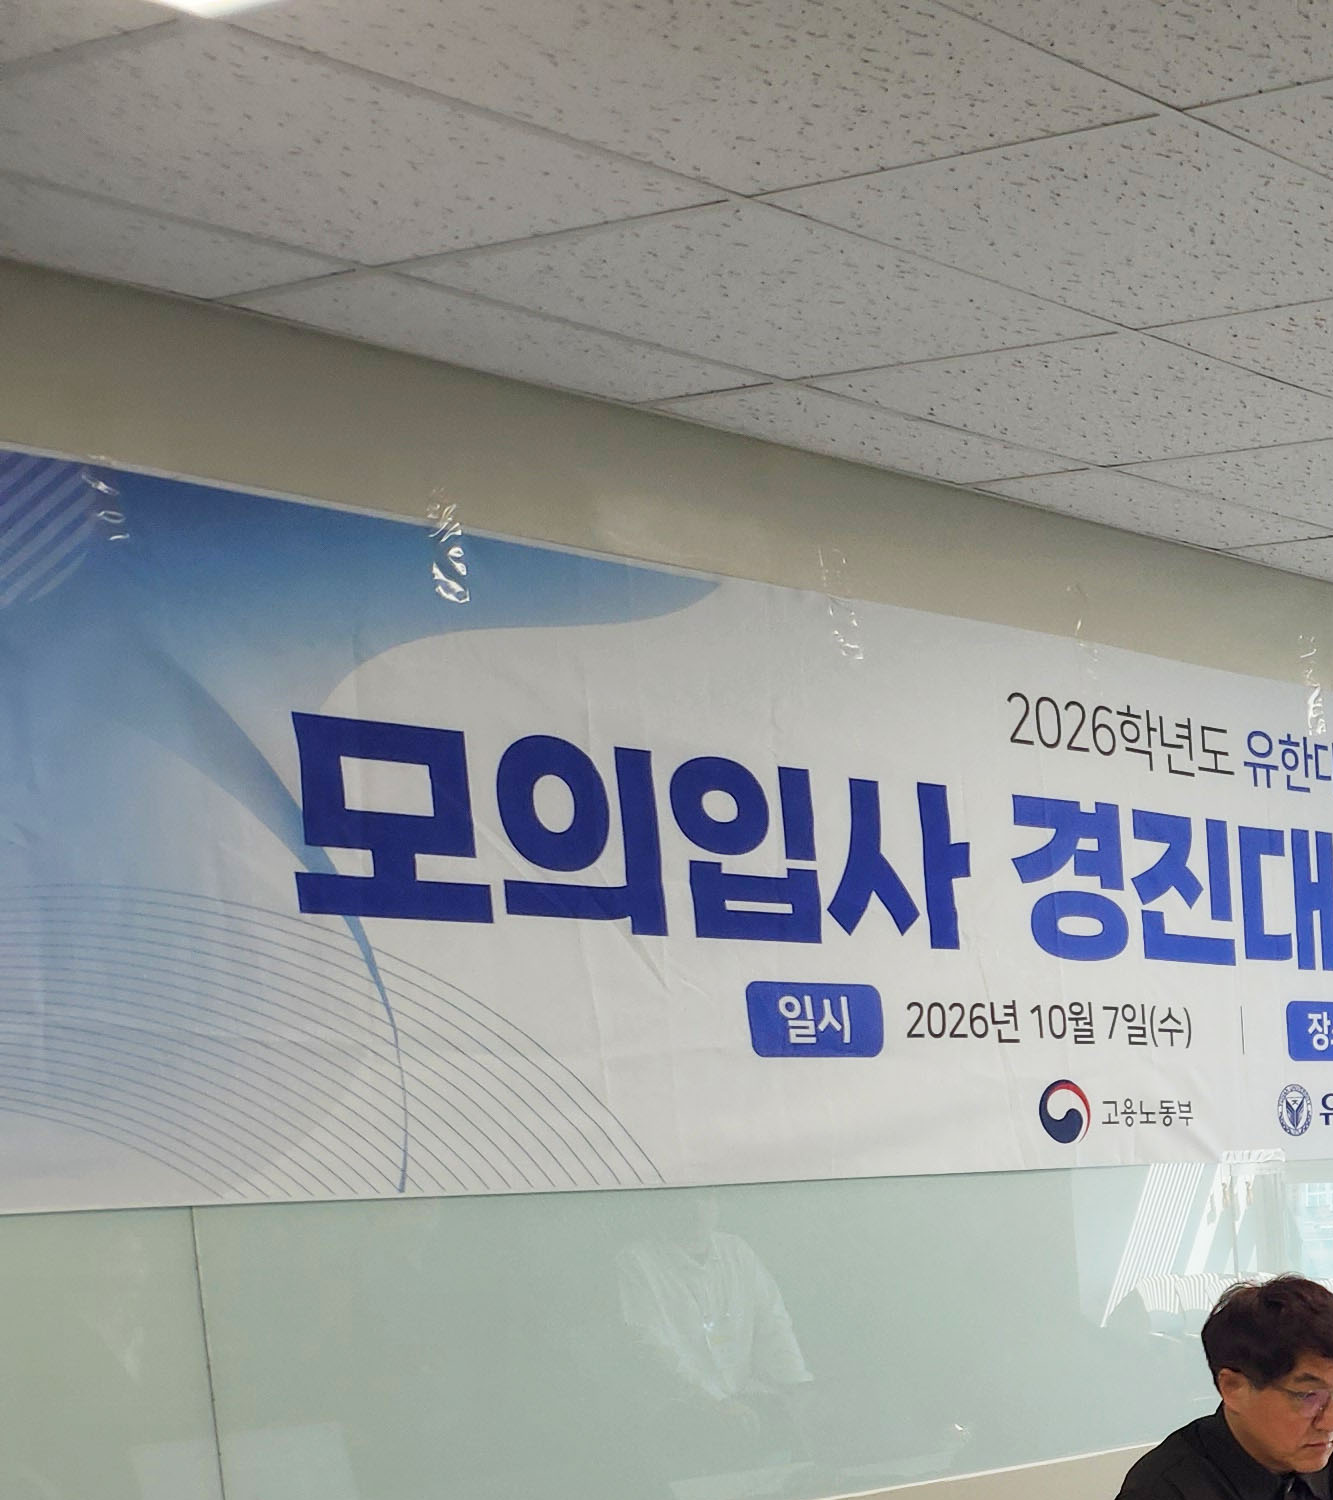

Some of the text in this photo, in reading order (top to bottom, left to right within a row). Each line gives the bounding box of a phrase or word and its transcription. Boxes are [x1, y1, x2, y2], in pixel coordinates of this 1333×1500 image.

[1007, 692, 1235, 777] 2026학년도
[292, 711, 970, 949] 모의입사
[778, 995, 1192, 1049] 일시 2026년 10월 7일(수)
[1101, 1097, 1194, 1127] 고용노동부
